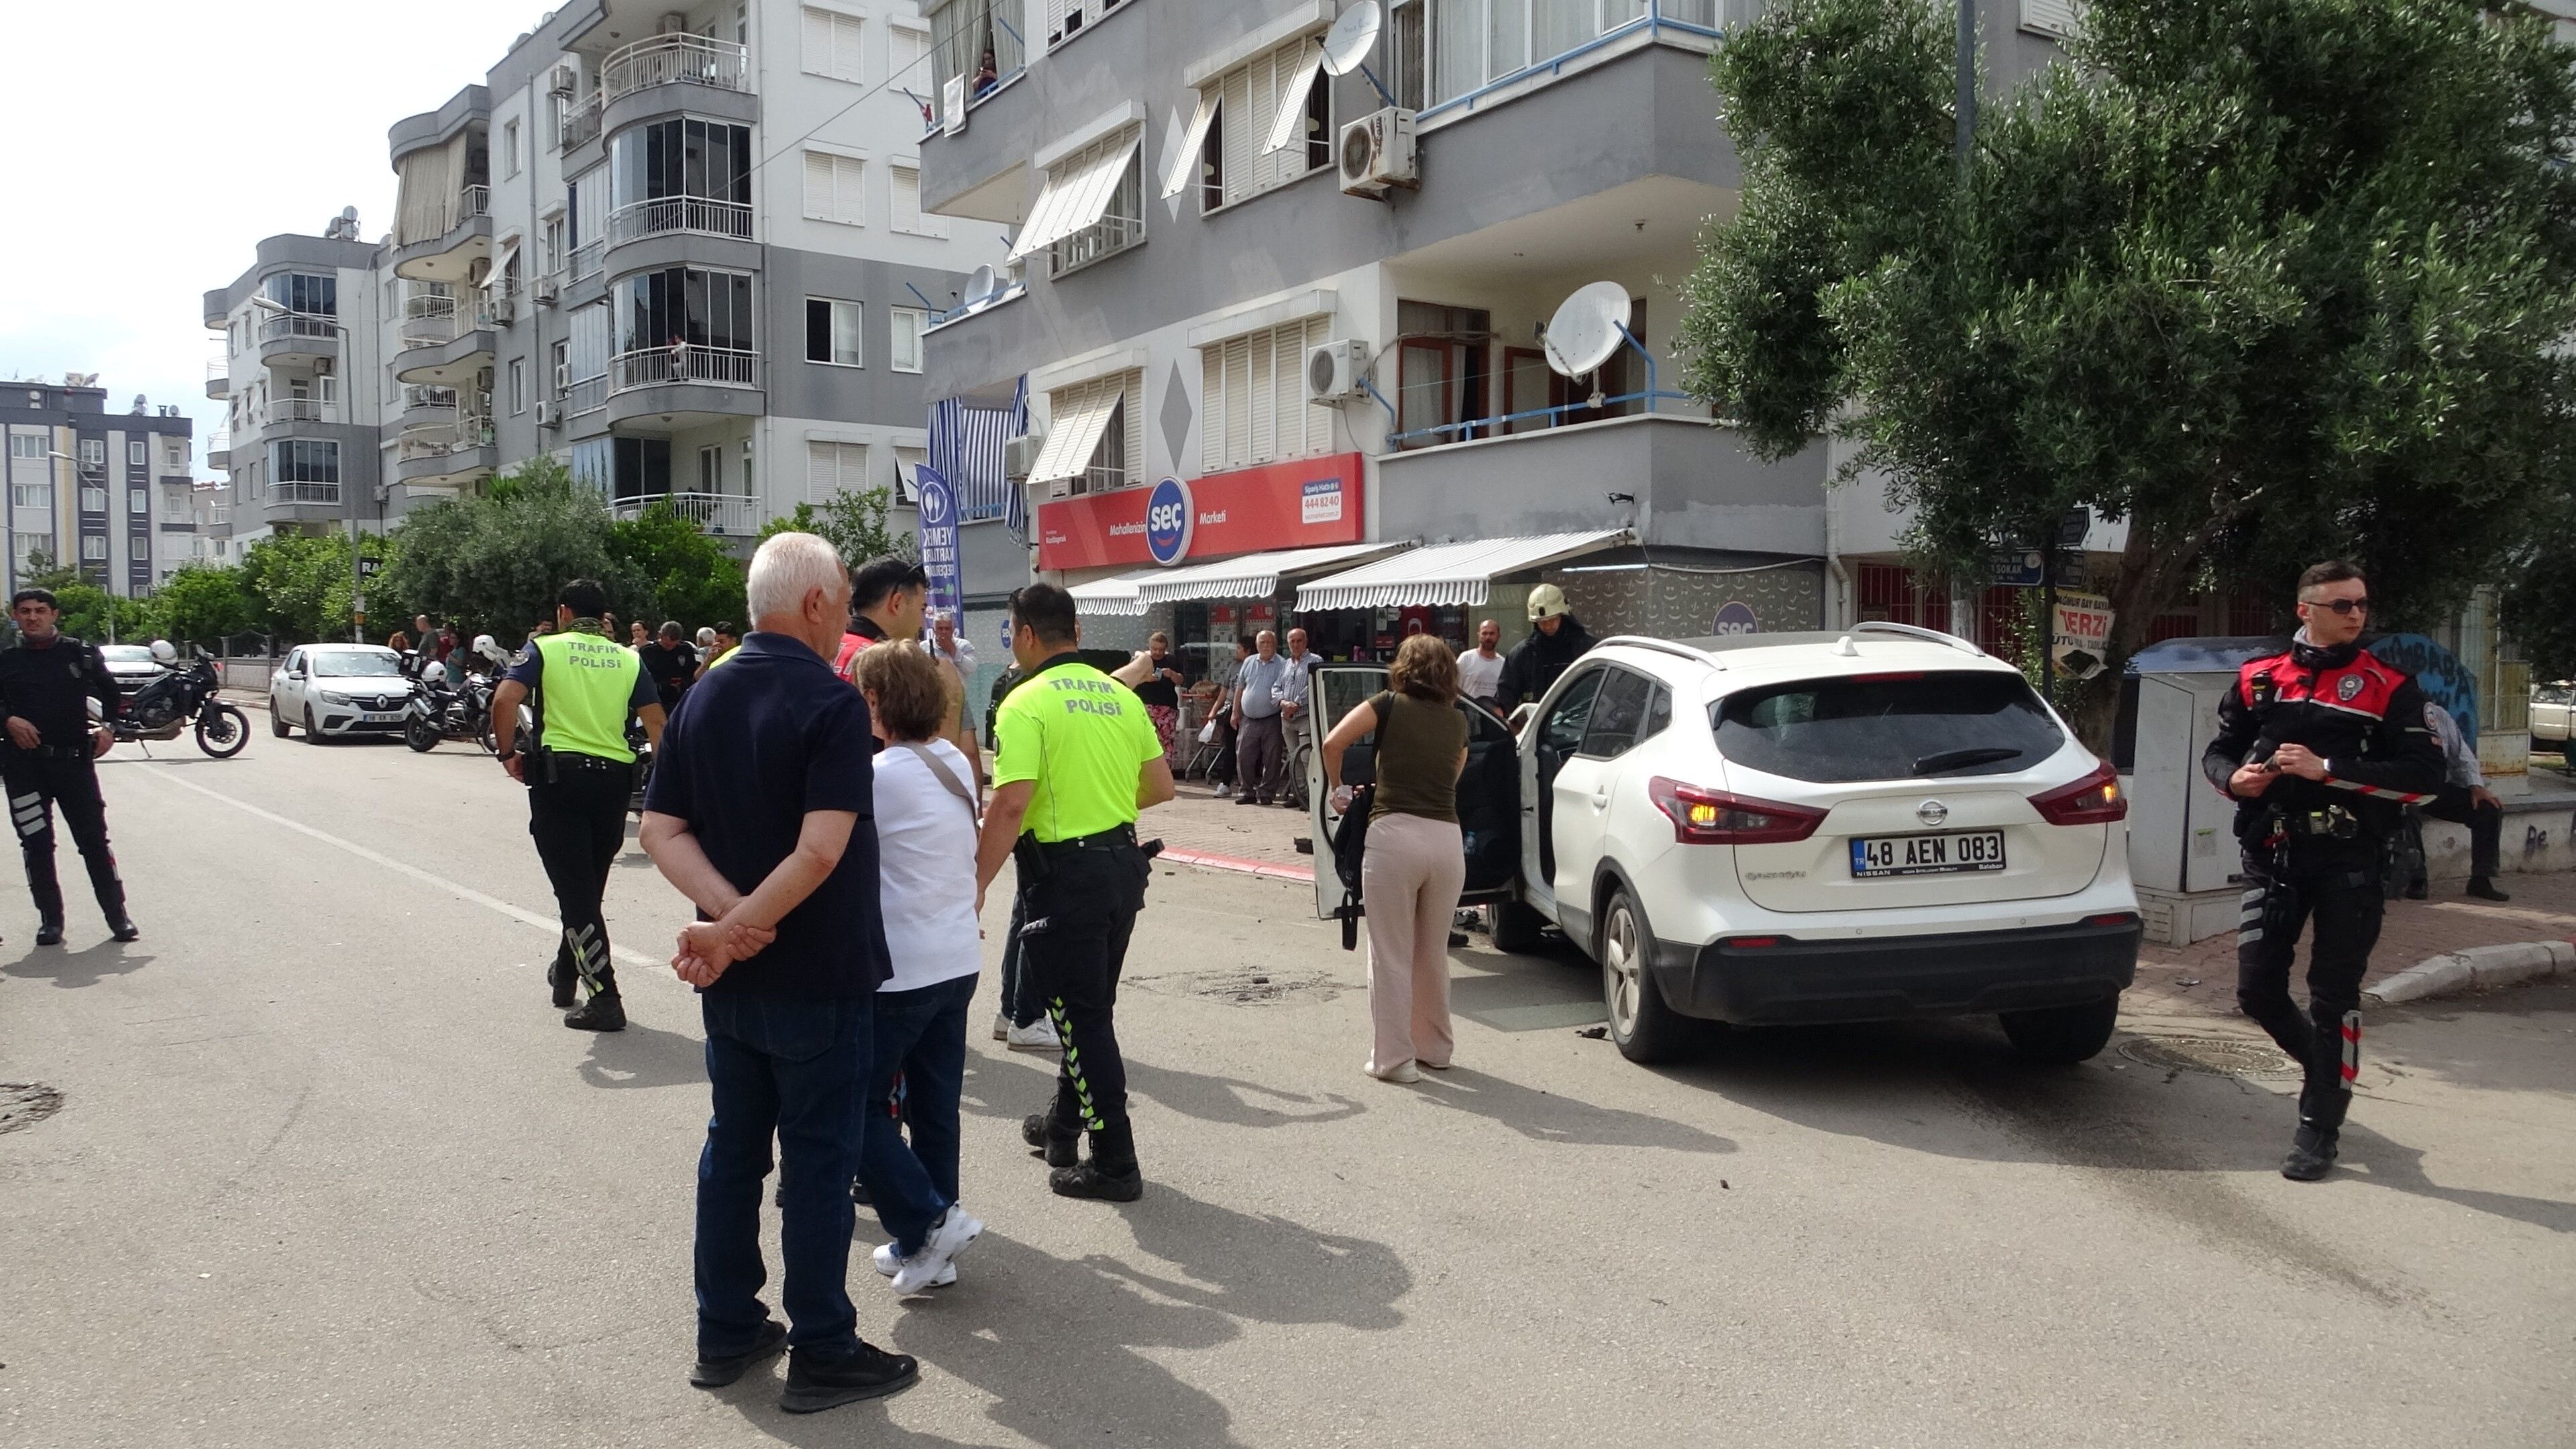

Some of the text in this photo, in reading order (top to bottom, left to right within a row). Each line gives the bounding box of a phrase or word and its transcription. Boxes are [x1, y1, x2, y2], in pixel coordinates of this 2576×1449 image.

[1151, 502, 1181, 531] seç
[1199, 510, 1226, 525] Marketi
[1855, 835, 1999, 866] TR 48 AEN 083
[1856, 869, 1891, 877] NISSAN
